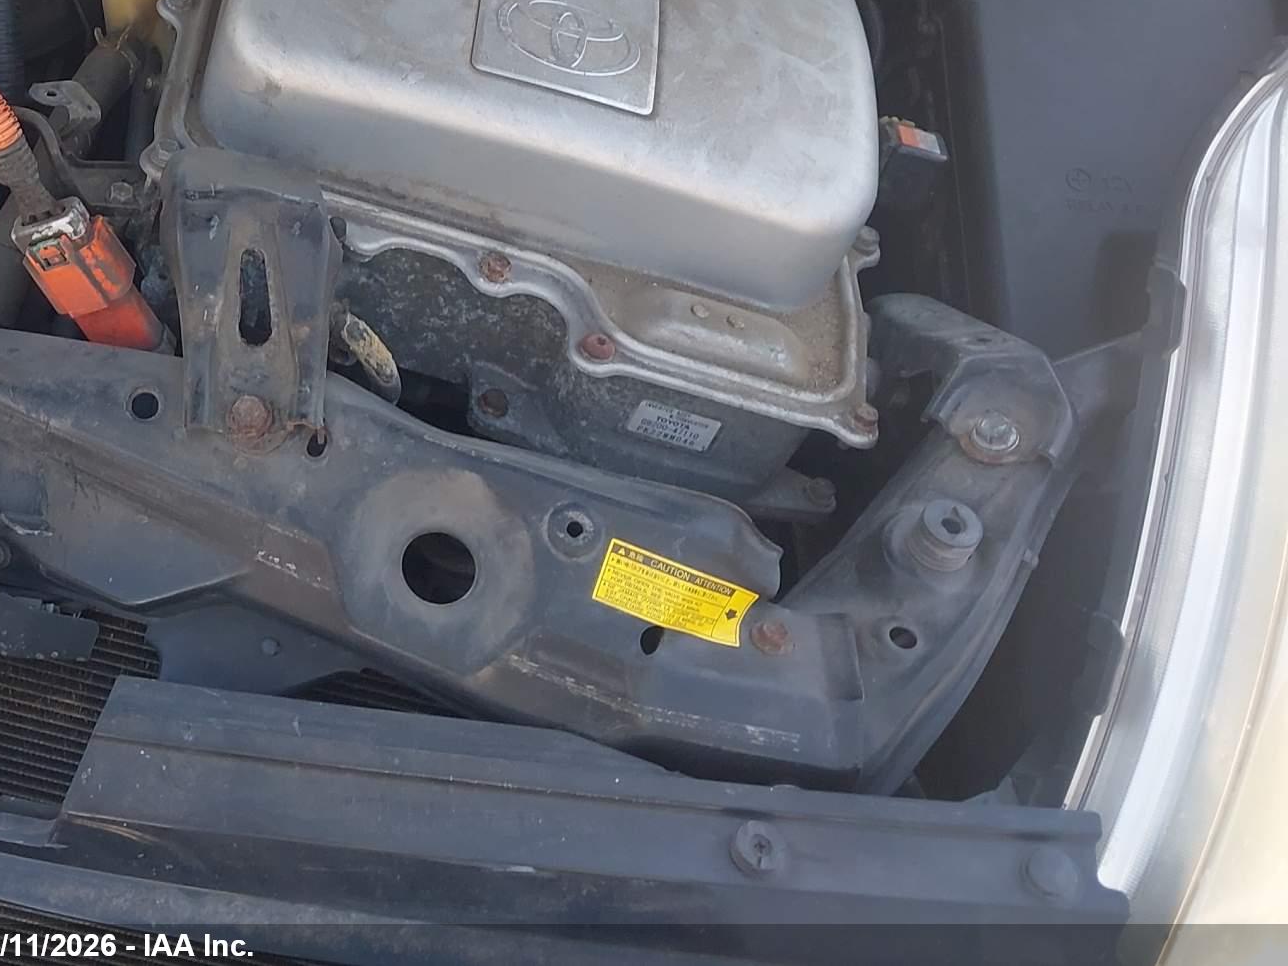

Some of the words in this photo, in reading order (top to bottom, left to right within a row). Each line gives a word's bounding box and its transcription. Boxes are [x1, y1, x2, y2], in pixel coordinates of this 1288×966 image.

[656, 416, 691, 430] TOYOTA
[650, 560, 691, 582] CAUTION
[695, 576, 732, 595] ATTENTION
